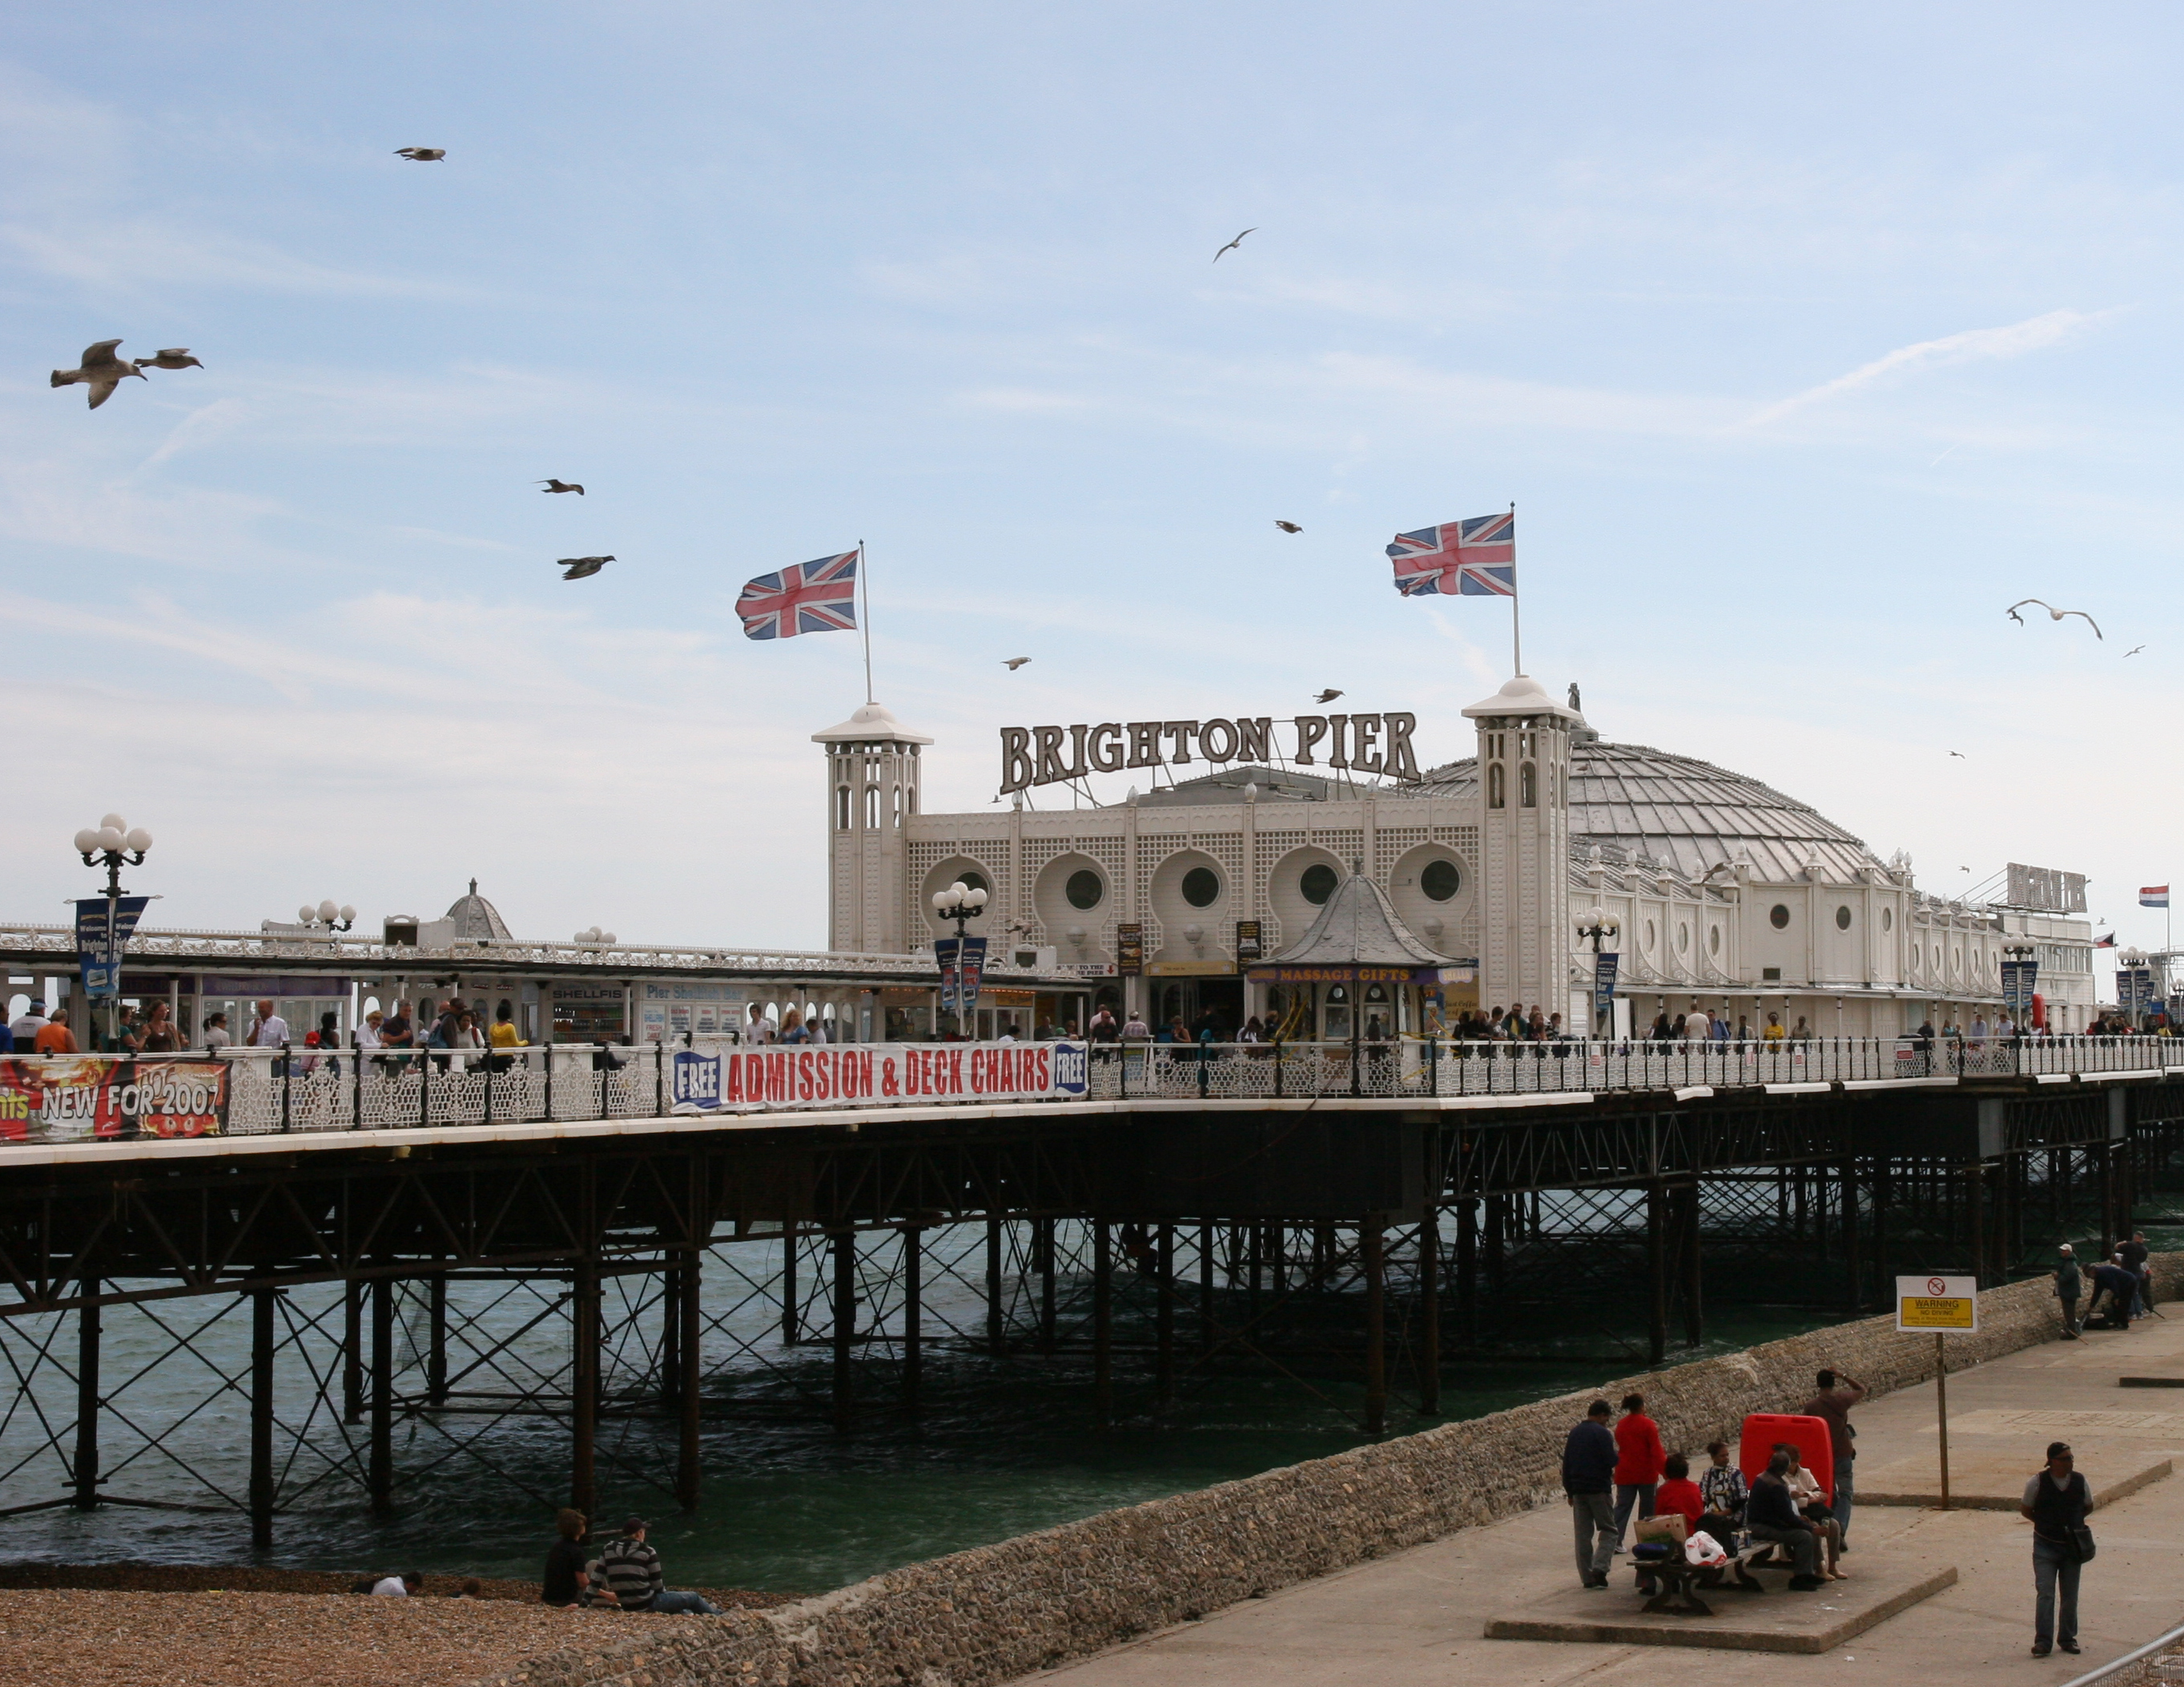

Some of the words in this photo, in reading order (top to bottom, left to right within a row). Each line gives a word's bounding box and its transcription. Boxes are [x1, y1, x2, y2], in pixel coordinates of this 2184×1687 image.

[1000, 717, 1273, 794] BRIGHTON
[1294, 712, 1422, 782] PIER
[82, 939, 108, 954] Brighton
[96, 951, 108, 964] Pier
[1281, 970, 1353, 981] MASSAGE
[1357, 968, 1410, 981] GIFTS
[553, 990, 633, 998] SHELLFIS
[647, 985, 670, 999] Pier
[678, 1061, 718, 1100] FREE
[728, 1050, 873, 1103] ADMISSION
[882, 1057, 899, 1096] &
[906, 1049, 963, 1095] DECK
[971, 1047, 1048, 1094] CHAIRS
[1056, 1053, 1084, 1083] FREE
[42, 1085, 99, 1119] NEW
[107, 1084, 155, 1116] FOR
[162, 1083, 219, 1115] 2007
[1915, 1299, 1959, 1307] WARNING
